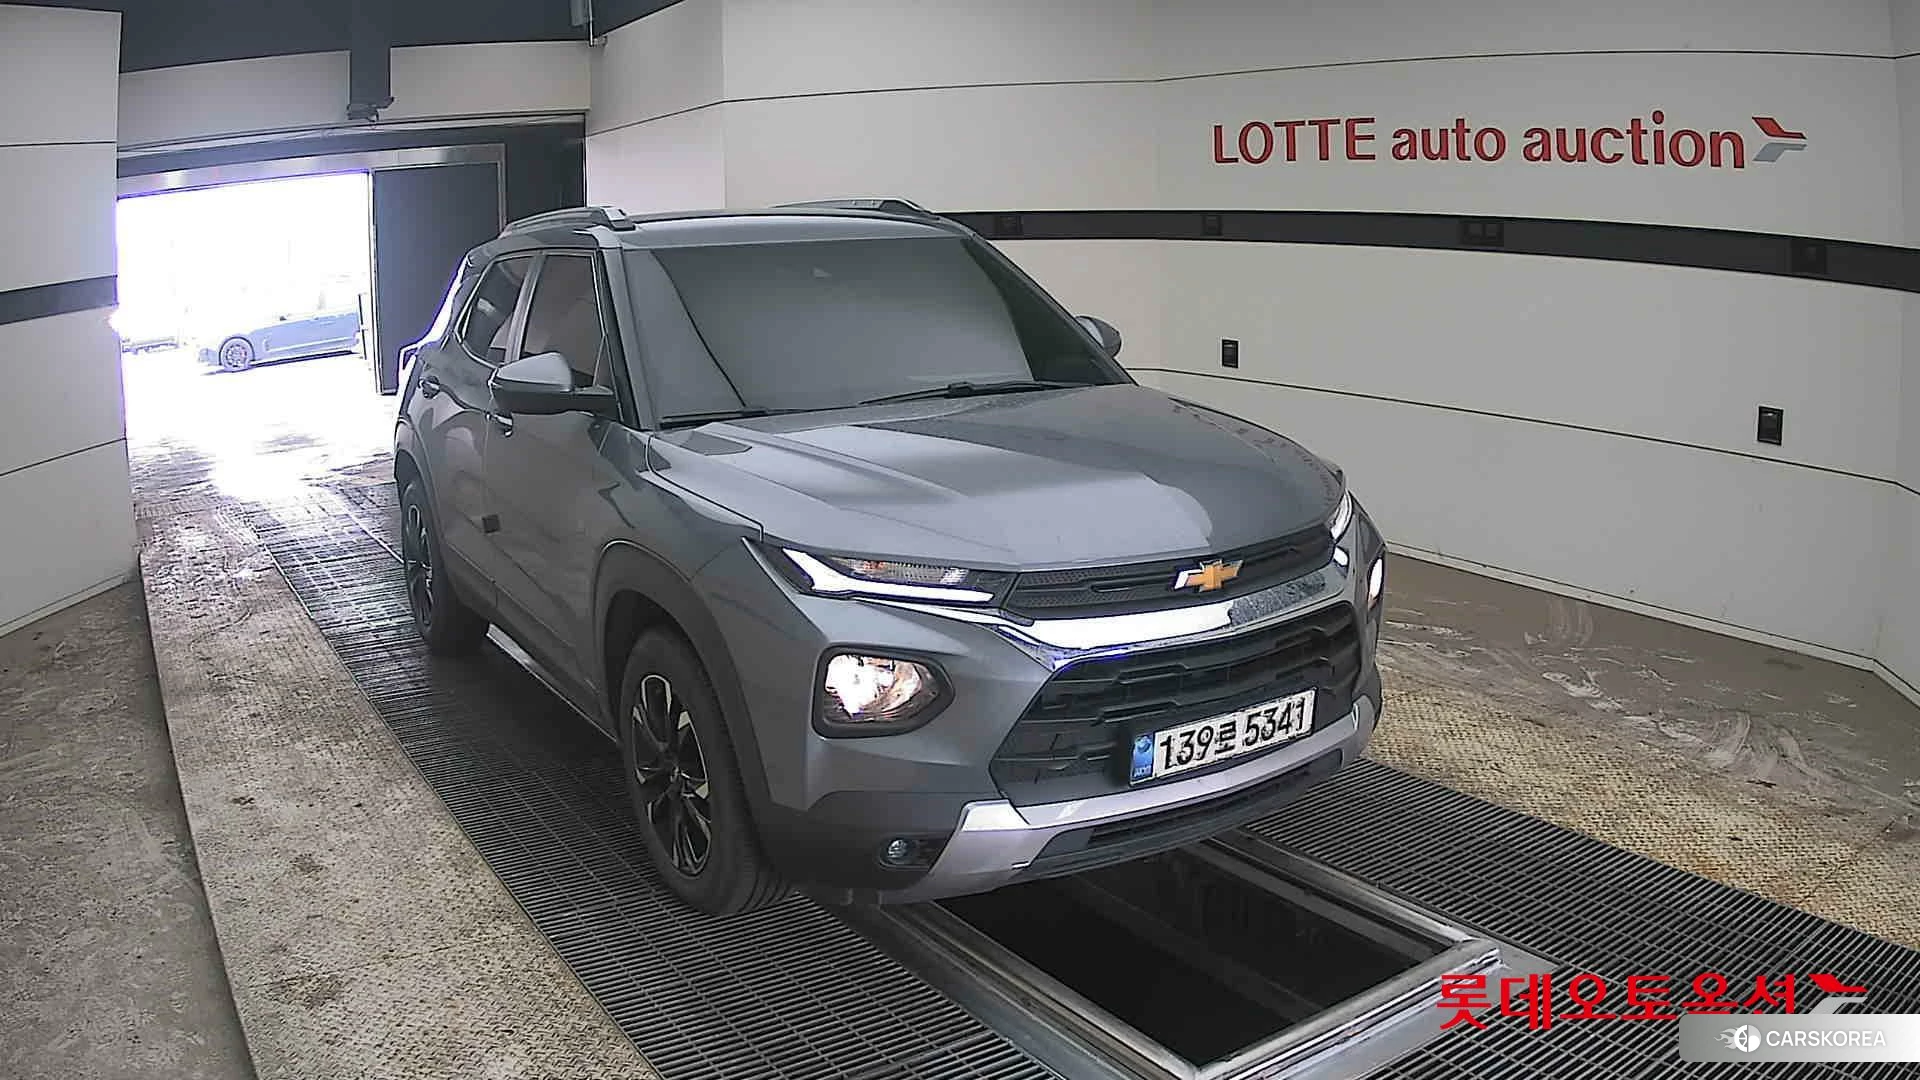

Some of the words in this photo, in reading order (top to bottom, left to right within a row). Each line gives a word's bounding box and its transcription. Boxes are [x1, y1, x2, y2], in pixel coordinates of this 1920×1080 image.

[1213, 117, 1377, 164] LOTTE
[1392, 117, 1508, 162] auto
[1522, 111, 1745, 169] auction
[1245, 696, 1306, 747] 5341
